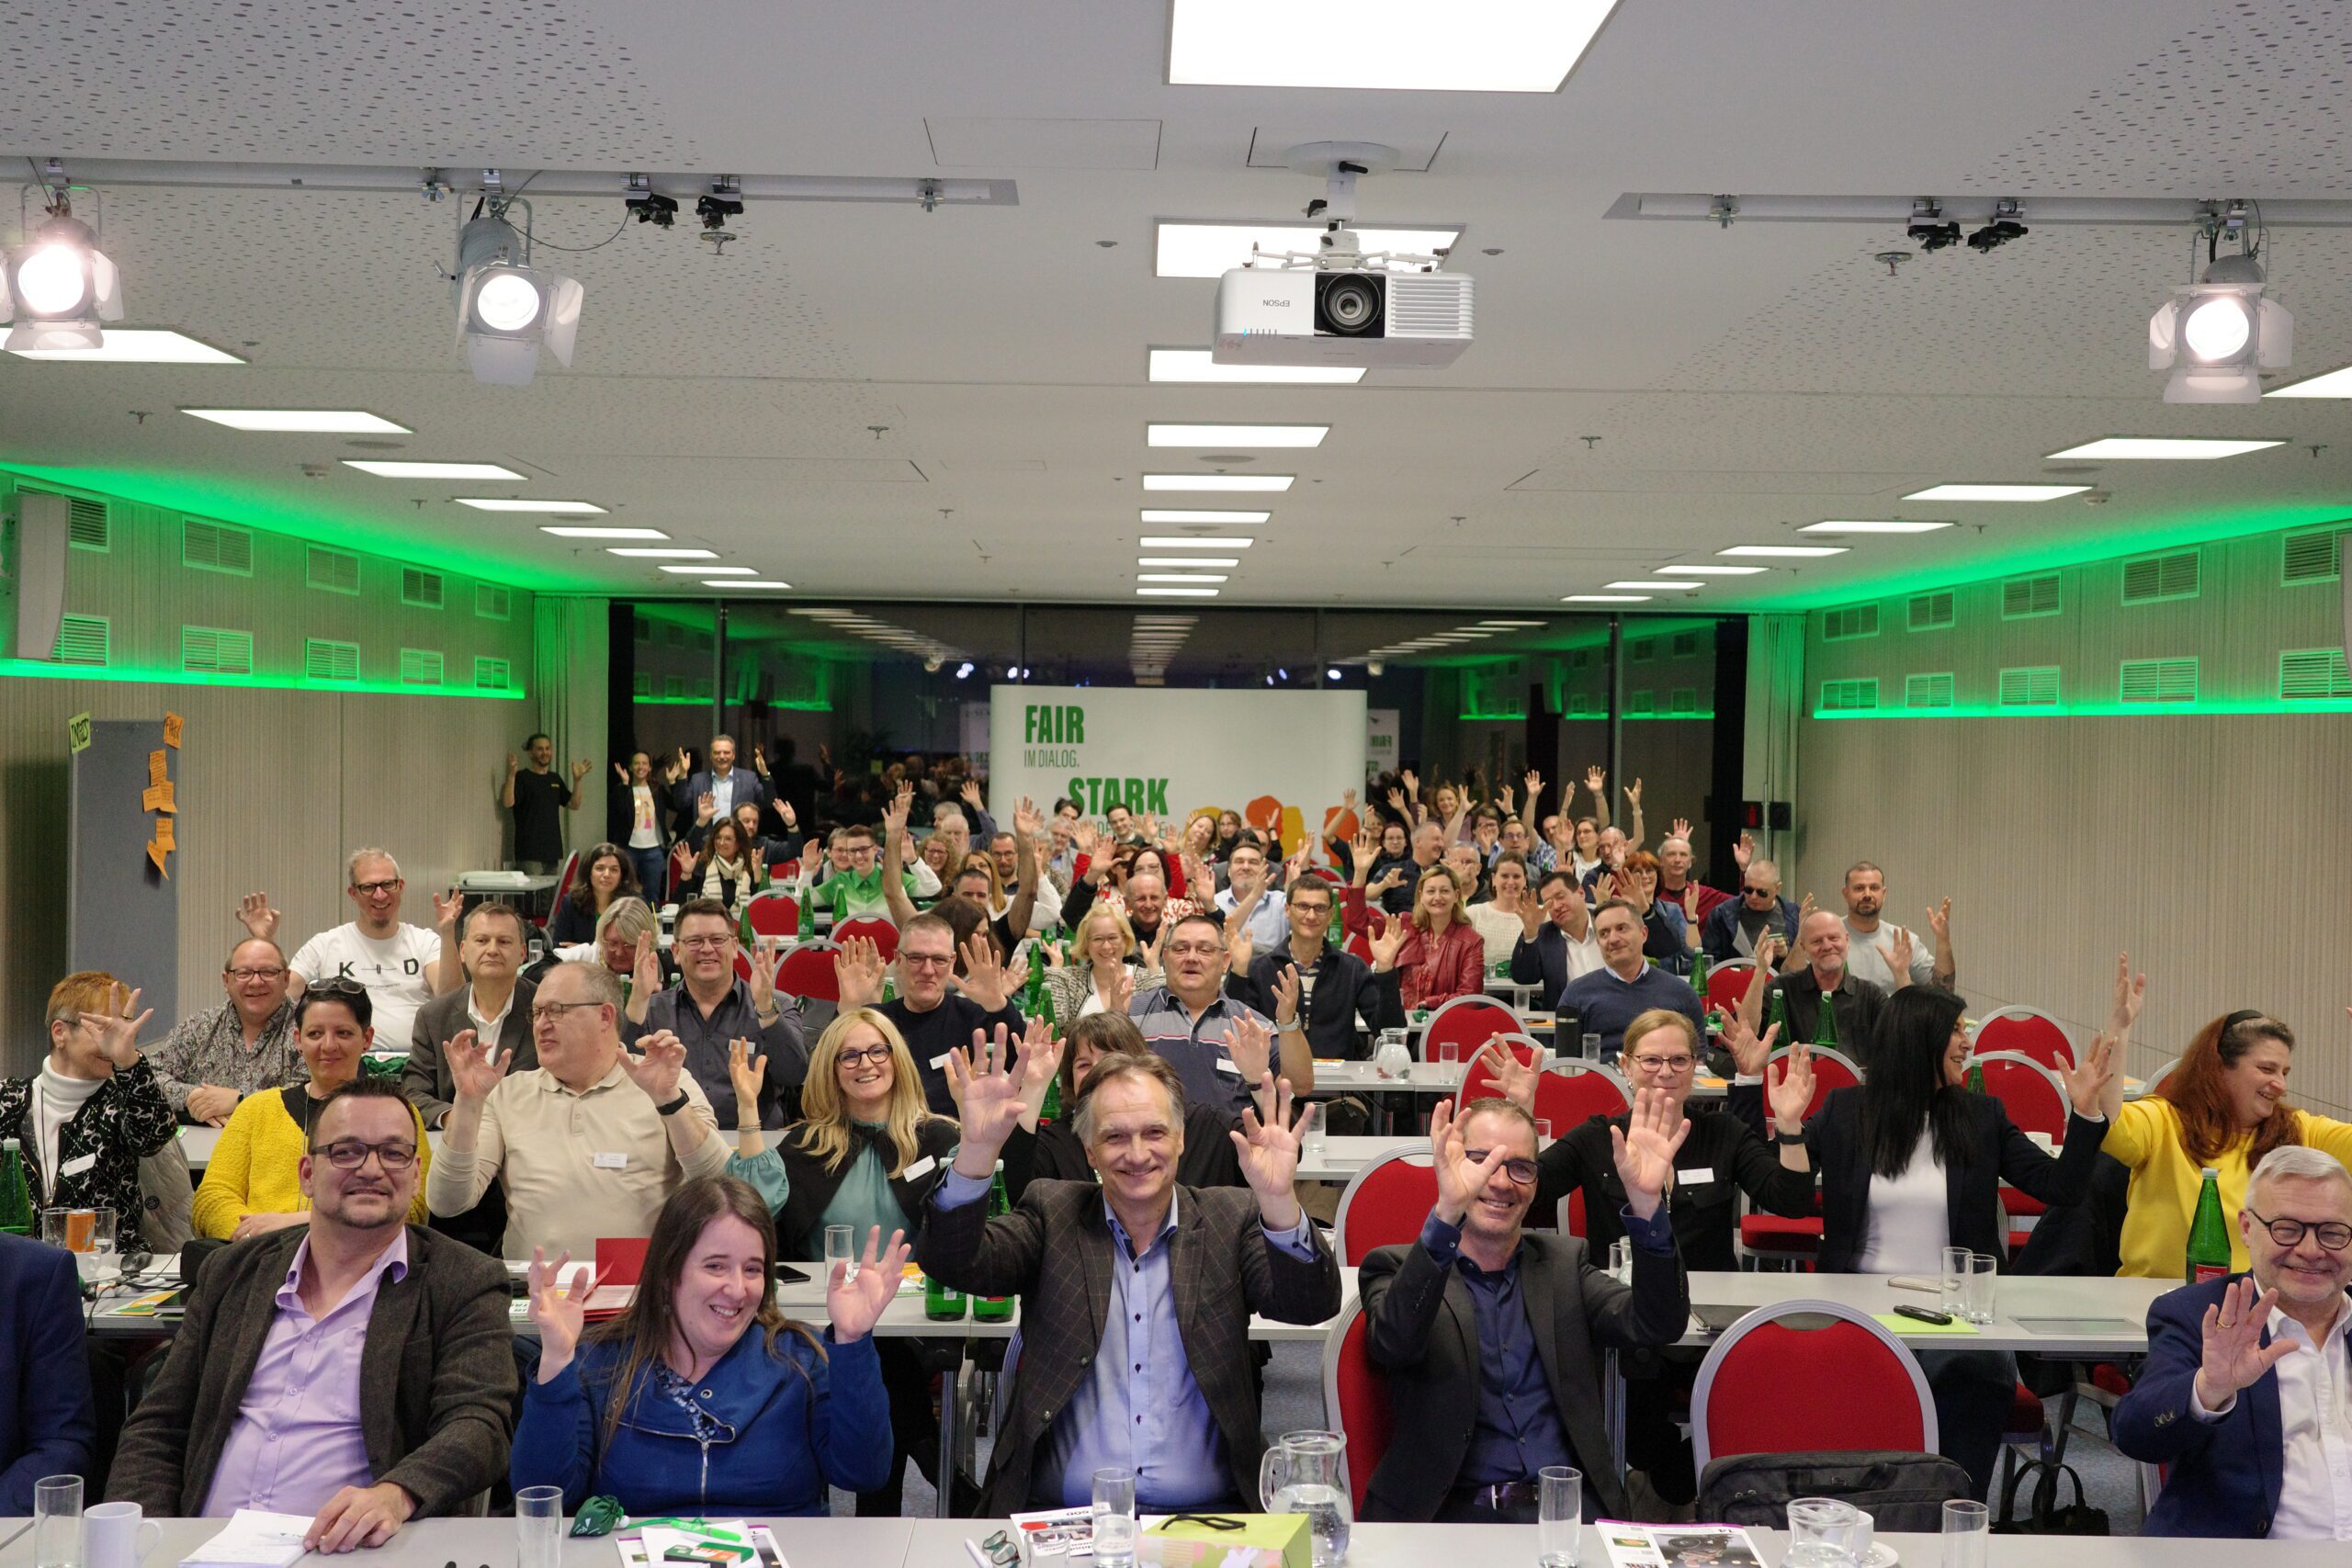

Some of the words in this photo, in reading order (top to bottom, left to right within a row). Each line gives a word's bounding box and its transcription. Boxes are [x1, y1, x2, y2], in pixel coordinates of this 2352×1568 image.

[1262, 299, 1290, 308] EPSON
[1025, 705, 1084, 744] FAIR
[1023, 749, 1035, 768] IM
[1038, 749, 1080, 768] DIALOG.
[1069, 777, 1169, 816] STARK
